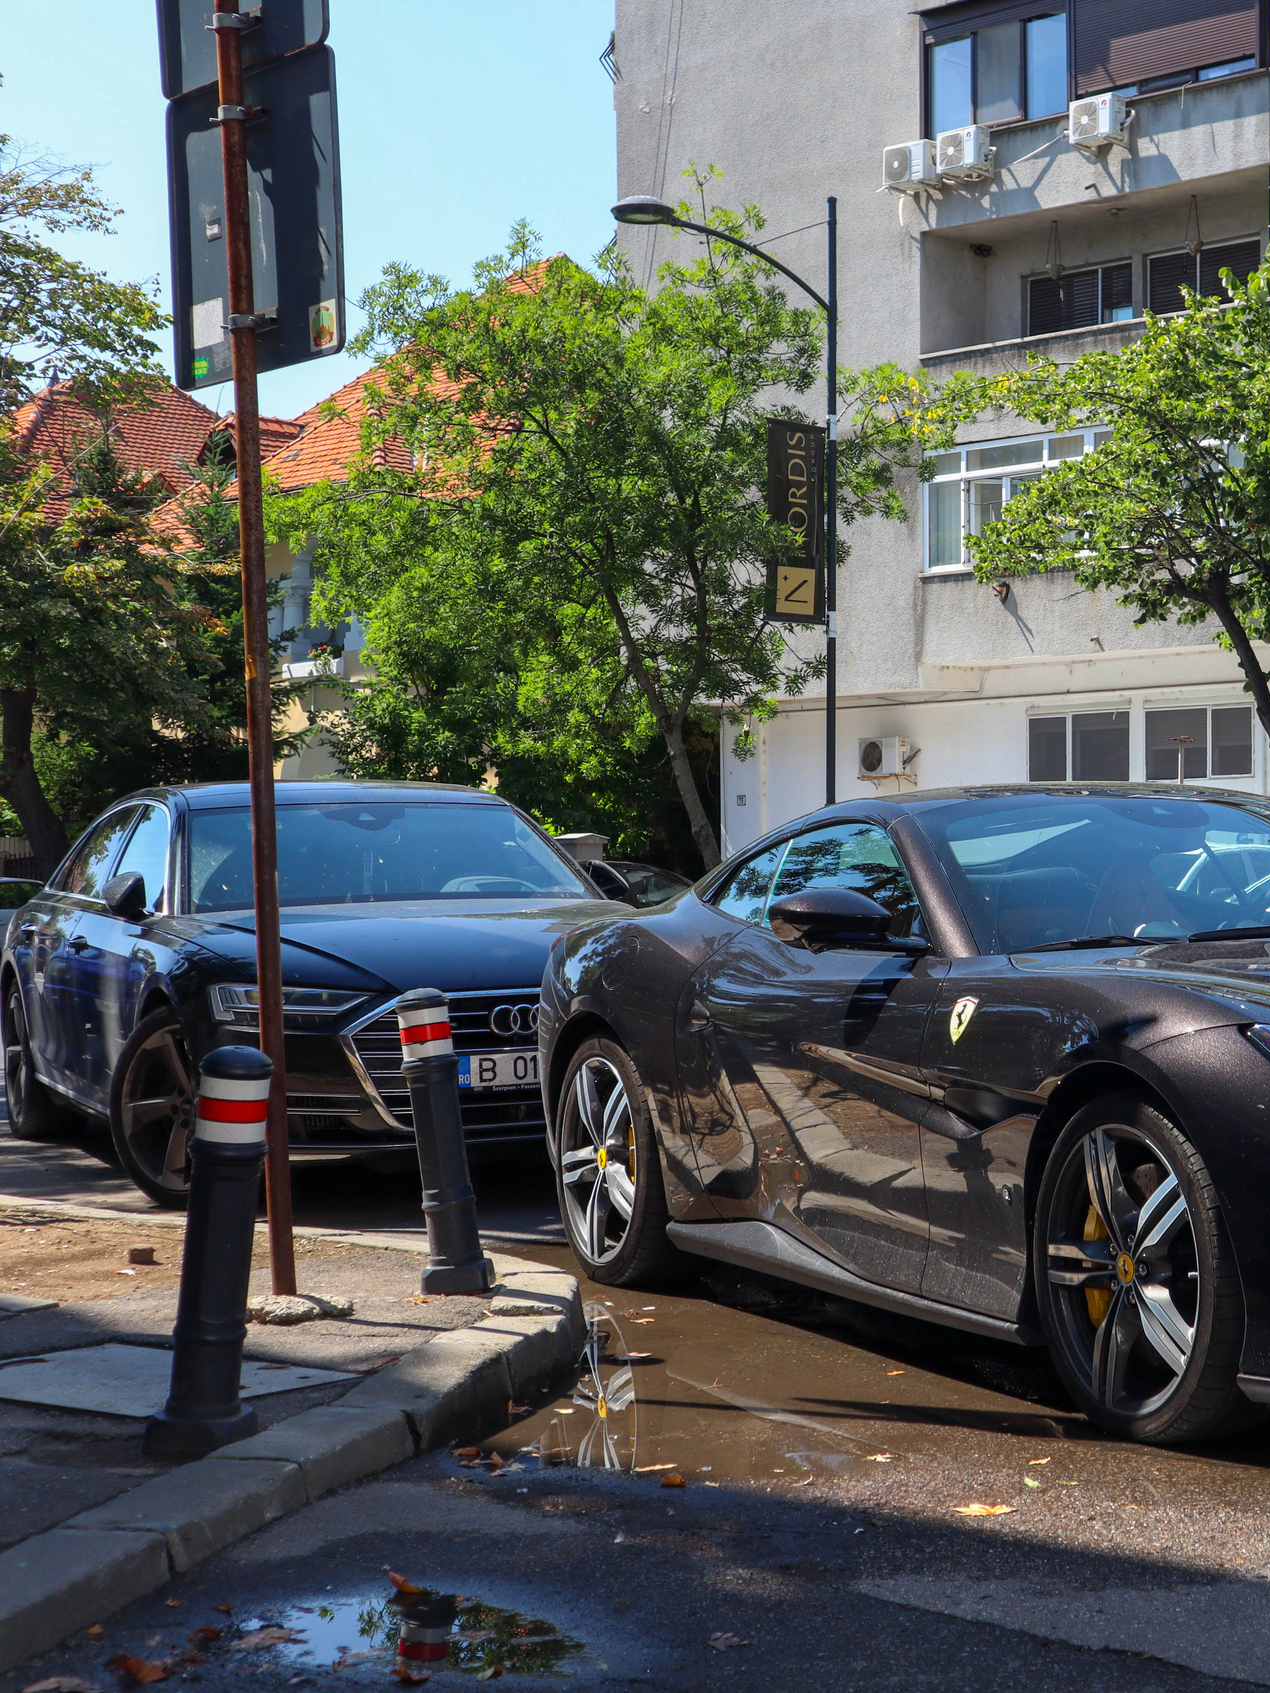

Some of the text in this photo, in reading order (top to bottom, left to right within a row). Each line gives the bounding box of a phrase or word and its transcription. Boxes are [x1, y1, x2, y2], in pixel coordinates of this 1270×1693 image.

[786, 431, 808, 558] ORDIS
[458, 1074, 470, 1085] RO
[479, 1055, 537, 1082] B 01
